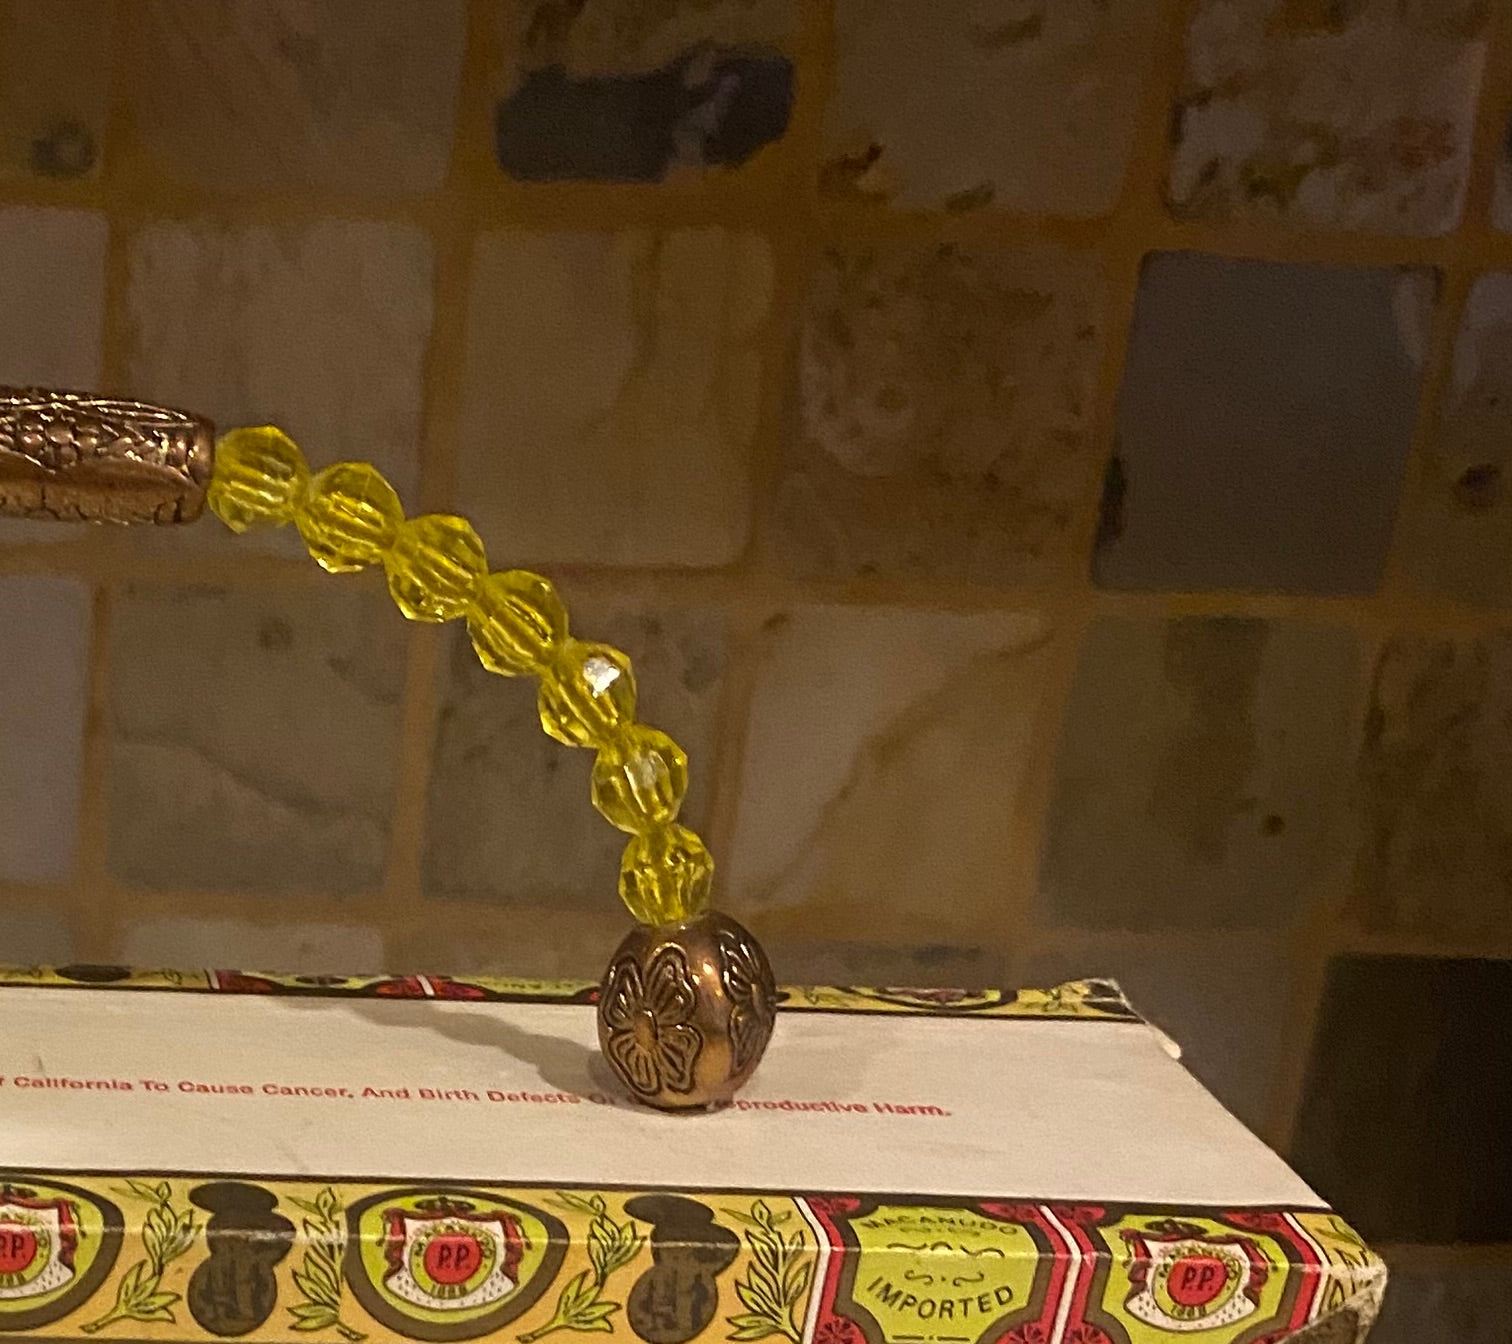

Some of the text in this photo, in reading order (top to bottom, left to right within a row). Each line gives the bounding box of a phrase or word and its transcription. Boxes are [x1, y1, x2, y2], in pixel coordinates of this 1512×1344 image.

[13, 1076, 134, 1092] California
[140, 1080, 170, 1092] To
[177, 1081, 254, 1095] Cause
[361, 1087, 411, 1100] And
[418, 1088, 480, 1102] Birth
[487, 1090, 582, 1105] Defects
[733, 1099, 953, 1117] productive Harm.
[866, 1275, 1014, 1320] IMPORTED
